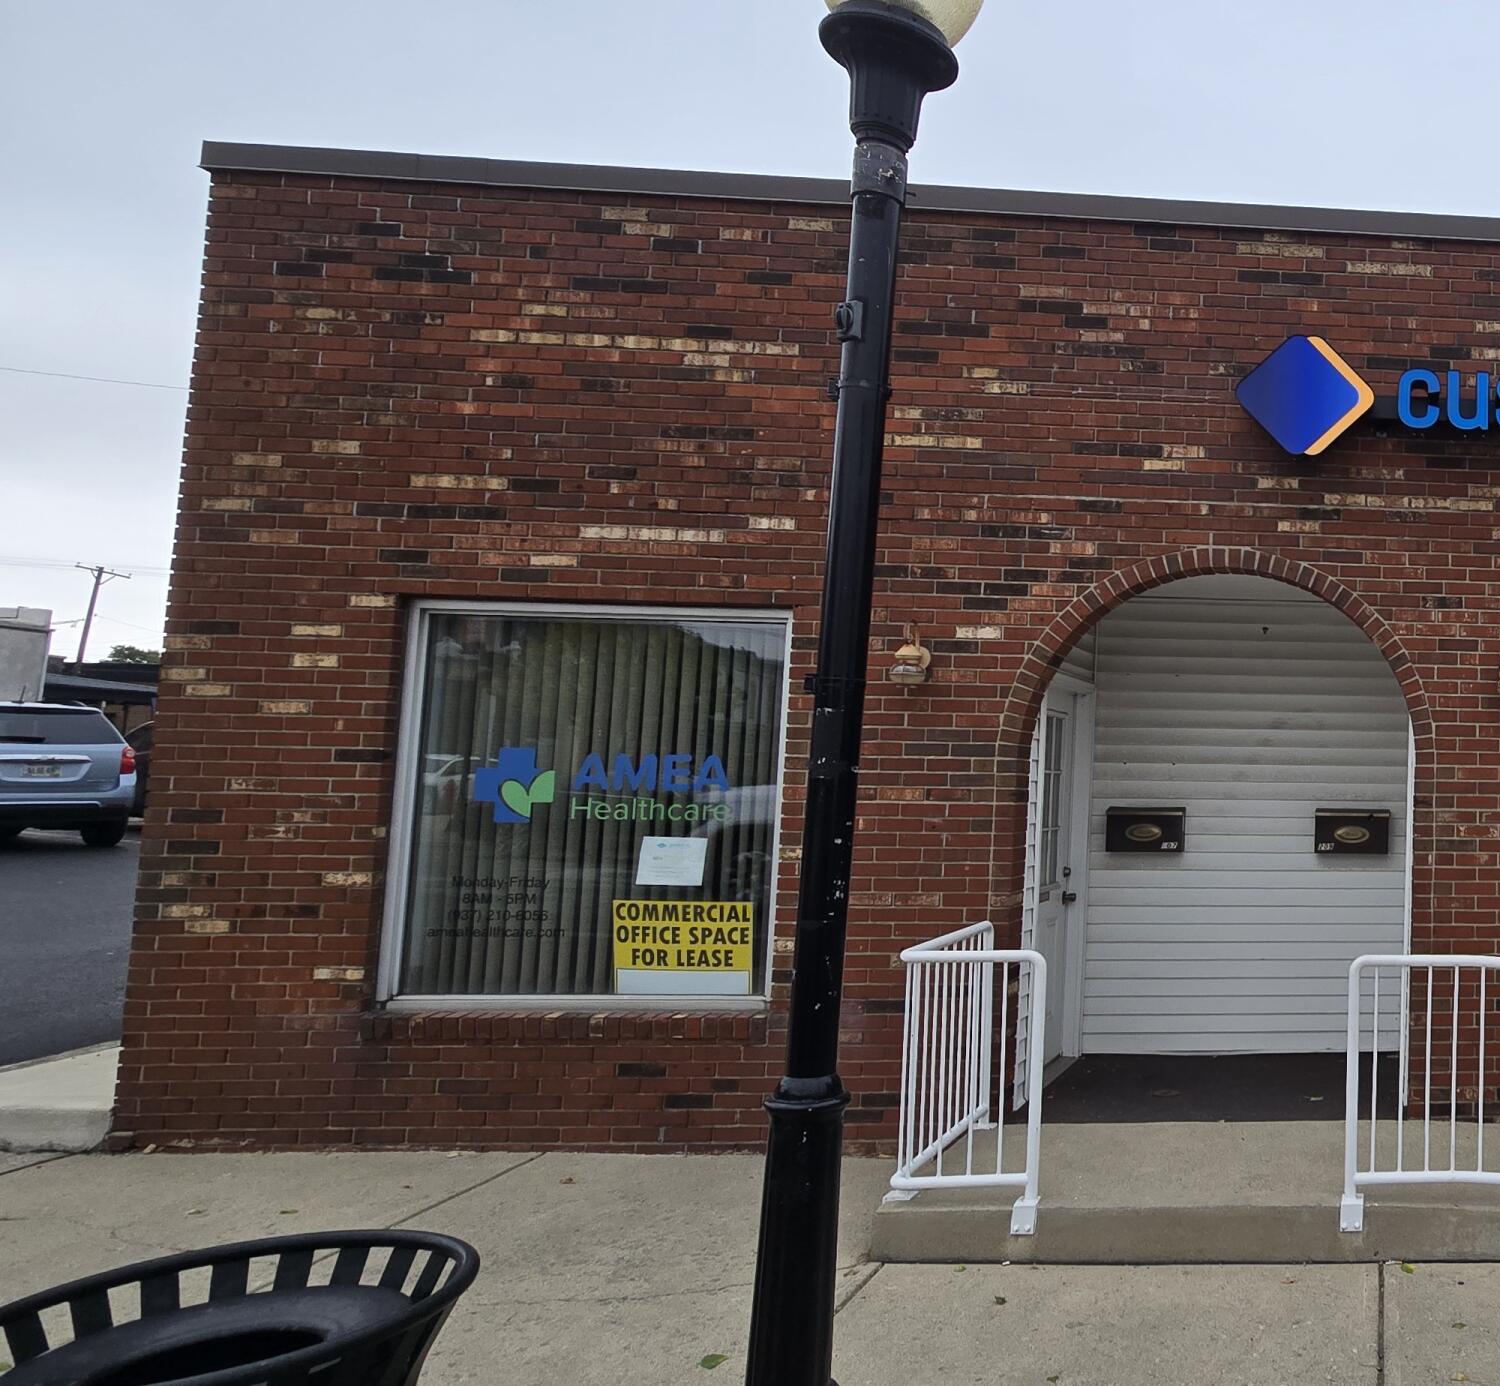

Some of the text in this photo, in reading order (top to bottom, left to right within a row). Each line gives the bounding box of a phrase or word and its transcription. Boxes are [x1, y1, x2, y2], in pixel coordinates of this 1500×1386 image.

[574, 753, 730, 792] AMEA
[570, 797, 732, 821] Healthcare
[615, 902, 751, 923] COMMERCIAL
[615, 925, 750, 946] OFFICE SPACE
[631, 948, 735, 968] FOR LEASE
